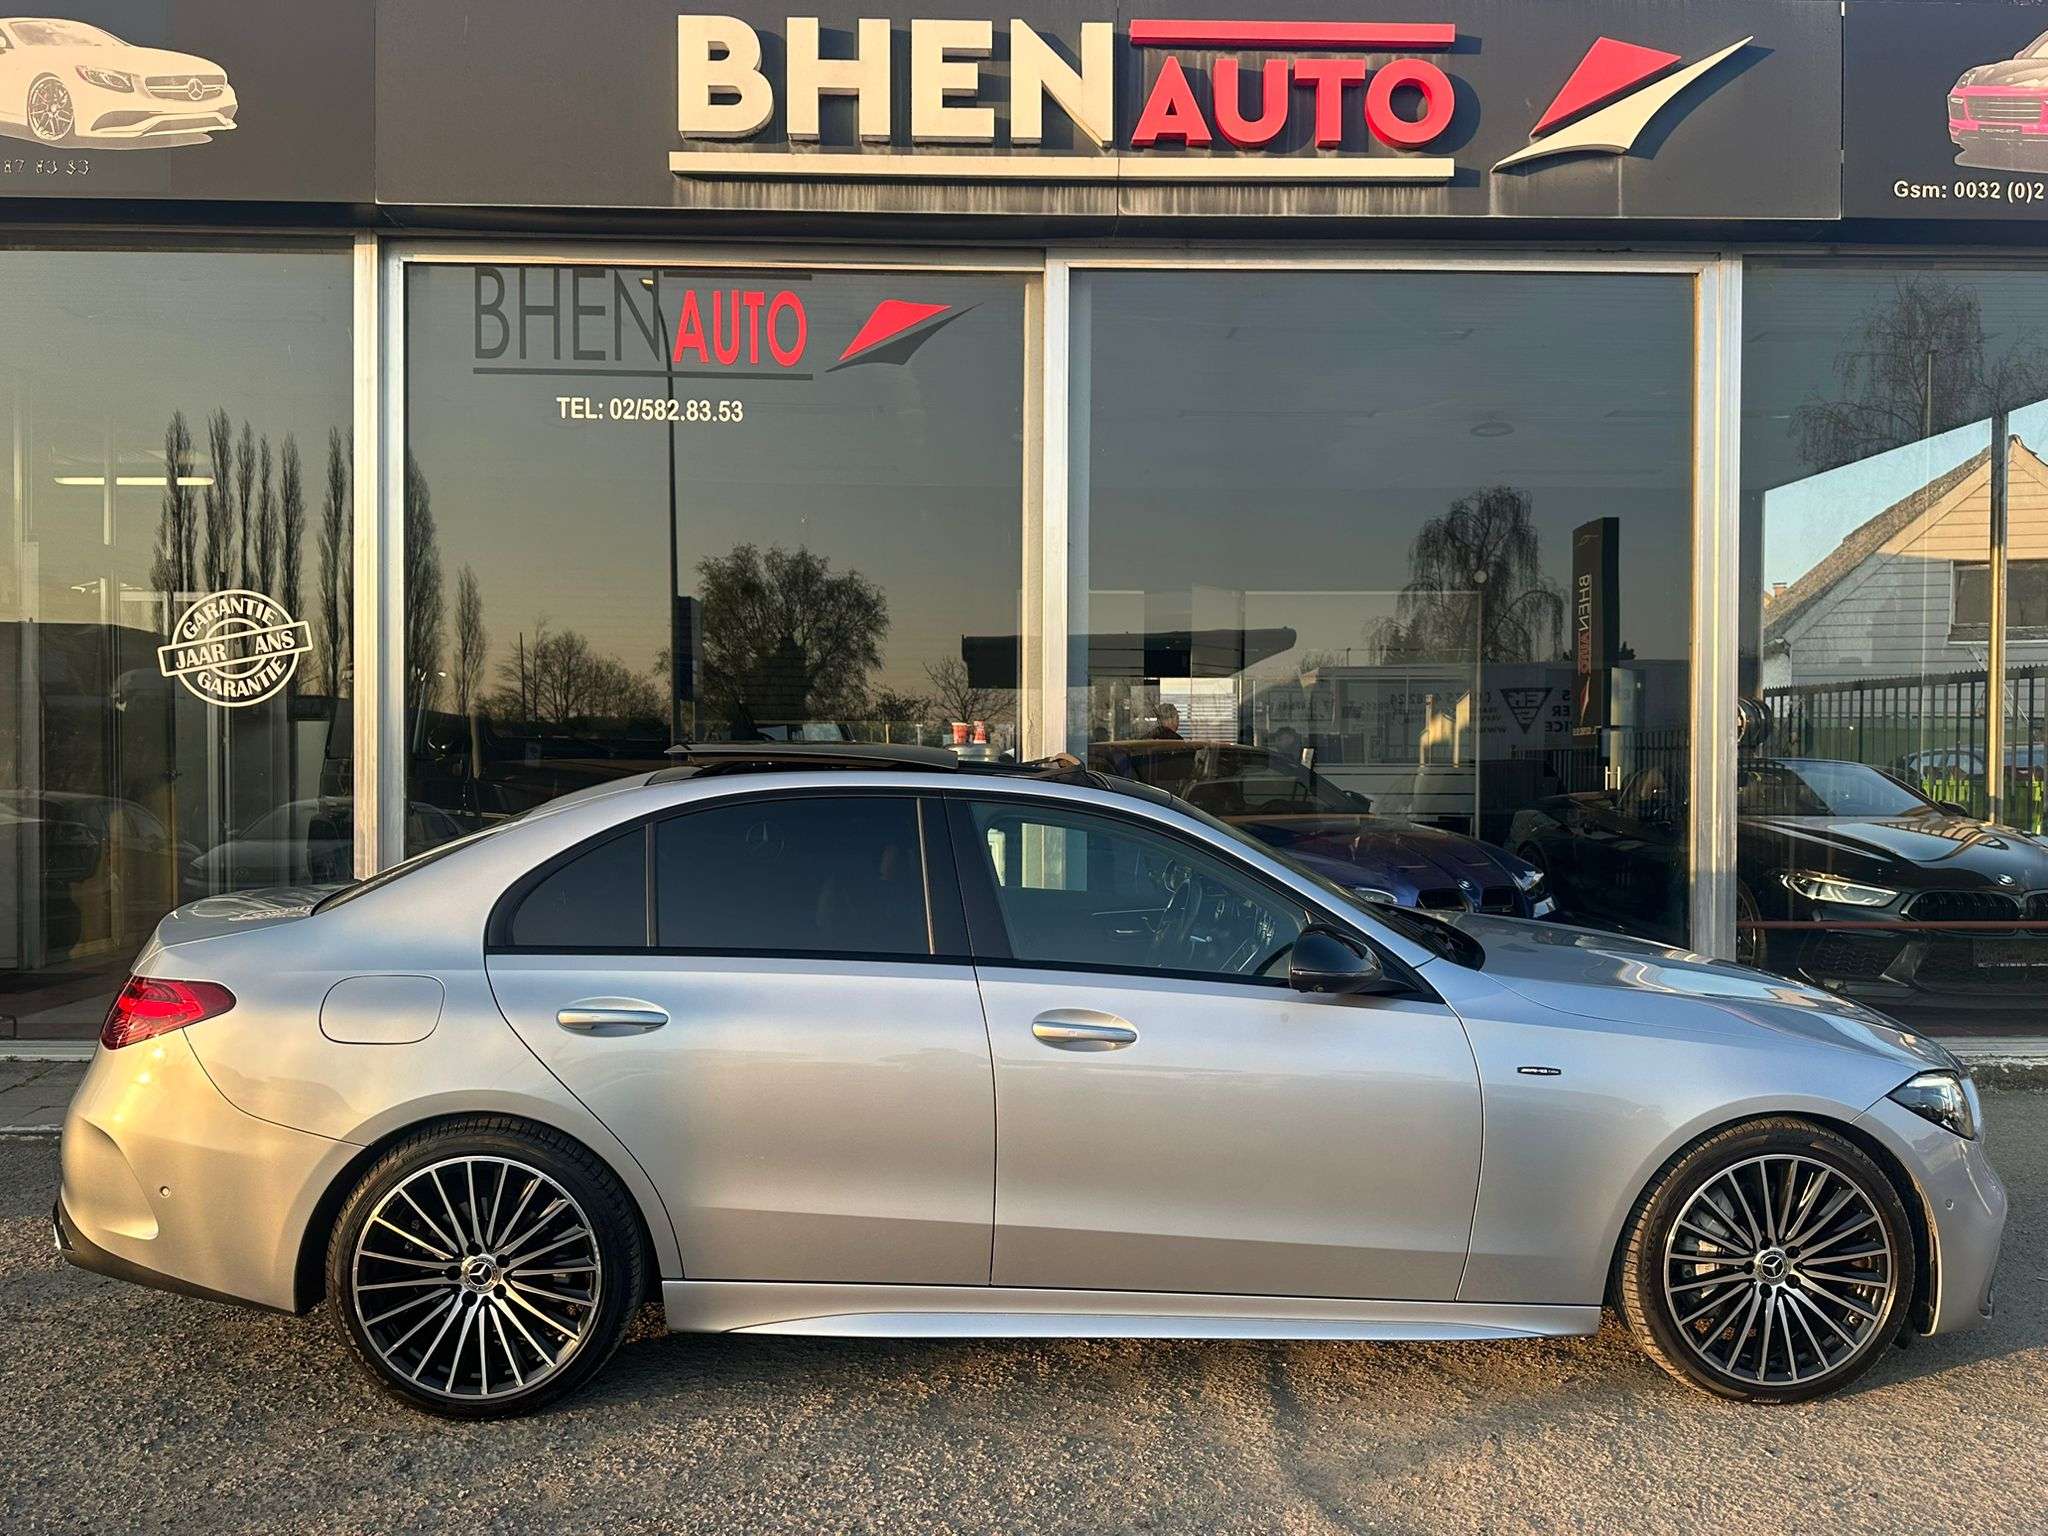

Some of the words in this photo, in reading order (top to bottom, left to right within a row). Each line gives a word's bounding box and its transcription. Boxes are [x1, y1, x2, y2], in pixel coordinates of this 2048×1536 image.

[677, 14, 1114, 147] BHEN
[1131, 55, 1456, 148] AUTO
[1893, 180, 1947, 199] Gsm:
[1953, 181, 2001, 200] 0032
[2007, 181, 2045, 204] (0)2
[473, 267, 661, 362] BHEN
[672, 289, 808, 368] AUTO
[556, 396, 604, 420] TEL:
[609, 398, 744, 423] 02/582.83.53
[182, 597, 278, 640] GARANTIE
[176, 643, 228, 669] JAAR
[255, 630, 296, 655] ANS
[197, 656, 287, 698] GARANTIE
